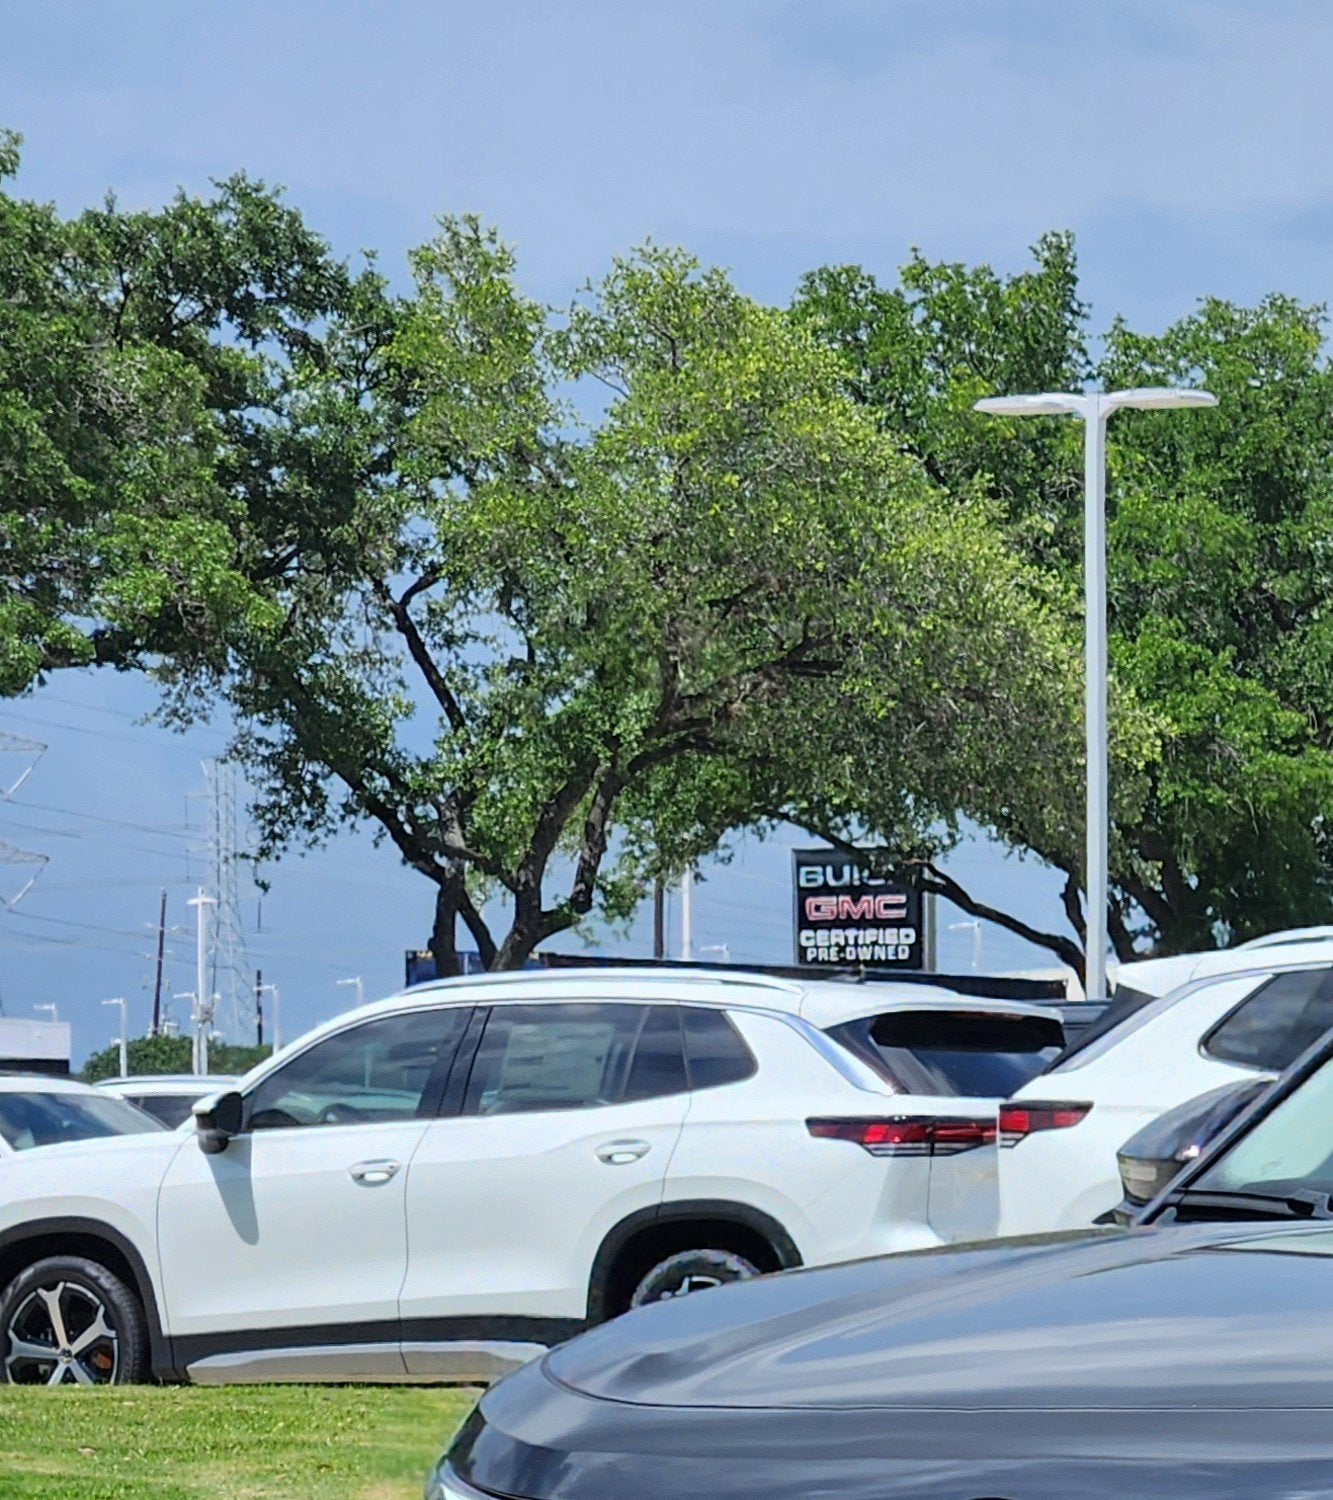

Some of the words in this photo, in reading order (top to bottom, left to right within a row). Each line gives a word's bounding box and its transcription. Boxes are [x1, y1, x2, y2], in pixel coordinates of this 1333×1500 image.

[805, 894, 907, 921] GMC
[799, 927, 916, 947] CERTIFIED
[806, 945, 910, 962] PRE-OWNED
